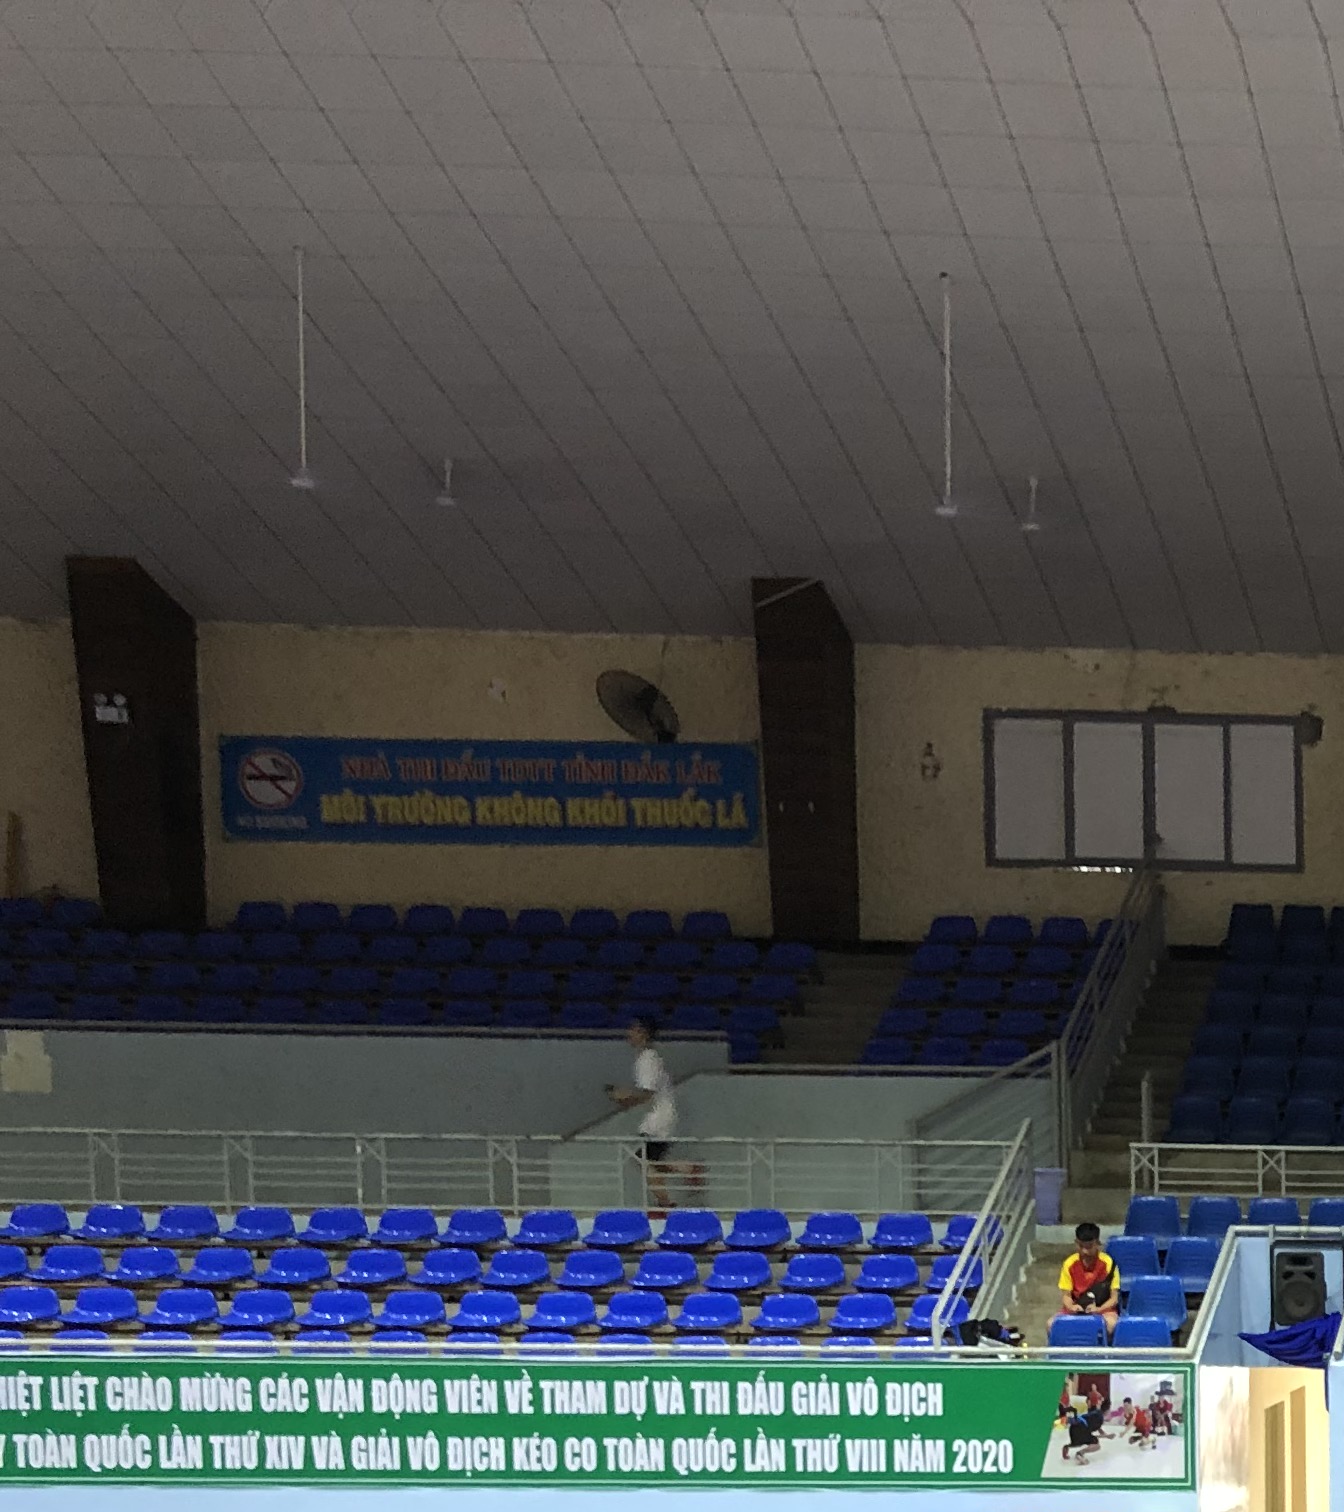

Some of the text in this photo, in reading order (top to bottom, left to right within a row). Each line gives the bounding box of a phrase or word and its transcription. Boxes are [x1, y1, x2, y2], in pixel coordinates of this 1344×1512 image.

[321, 787, 747, 828] MÔI TRƯỜNG KHÔNG THUỐC LÁ
[50, 1369, 943, 1422] LIỆT CHÀO MỪNG CÁC VẬN ĐỘNG VIÊN VỀ THAM DỰ VÀ THI ĐẤU GIẢI VÔ ĐỊCH
[12, 1427, 77, 1469] TOÀN
[83, 1423, 152, 1472] QUỐC
[158, 1423, 202, 1470] LẦN
[209, 1430, 260, 1470] THỨ
[264, 1435, 305, 1470] XIV
[311, 1430, 346, 1470] VÀ
[351, 1427, 400, 1471] GIẢI
[407, 1430, 440, 1471] VÔ
[446, 1436, 506, 1478] ĐỊCH
[512, 1432, 558, 1472] KÉO
[564, 1437, 597, 1472] CO
[603, 1432, 665, 1472] TOÀN
[671, 1427, 737, 1475] QUỐC
[743, 1427, 786, 1472] LẦN
[792, 1433, 841, 1473] THỨ
[845, 1439, 887, 1473] VIII
[894, 1433, 945, 1473] NĂM
[952, 1439, 1014, 1474] 2020
